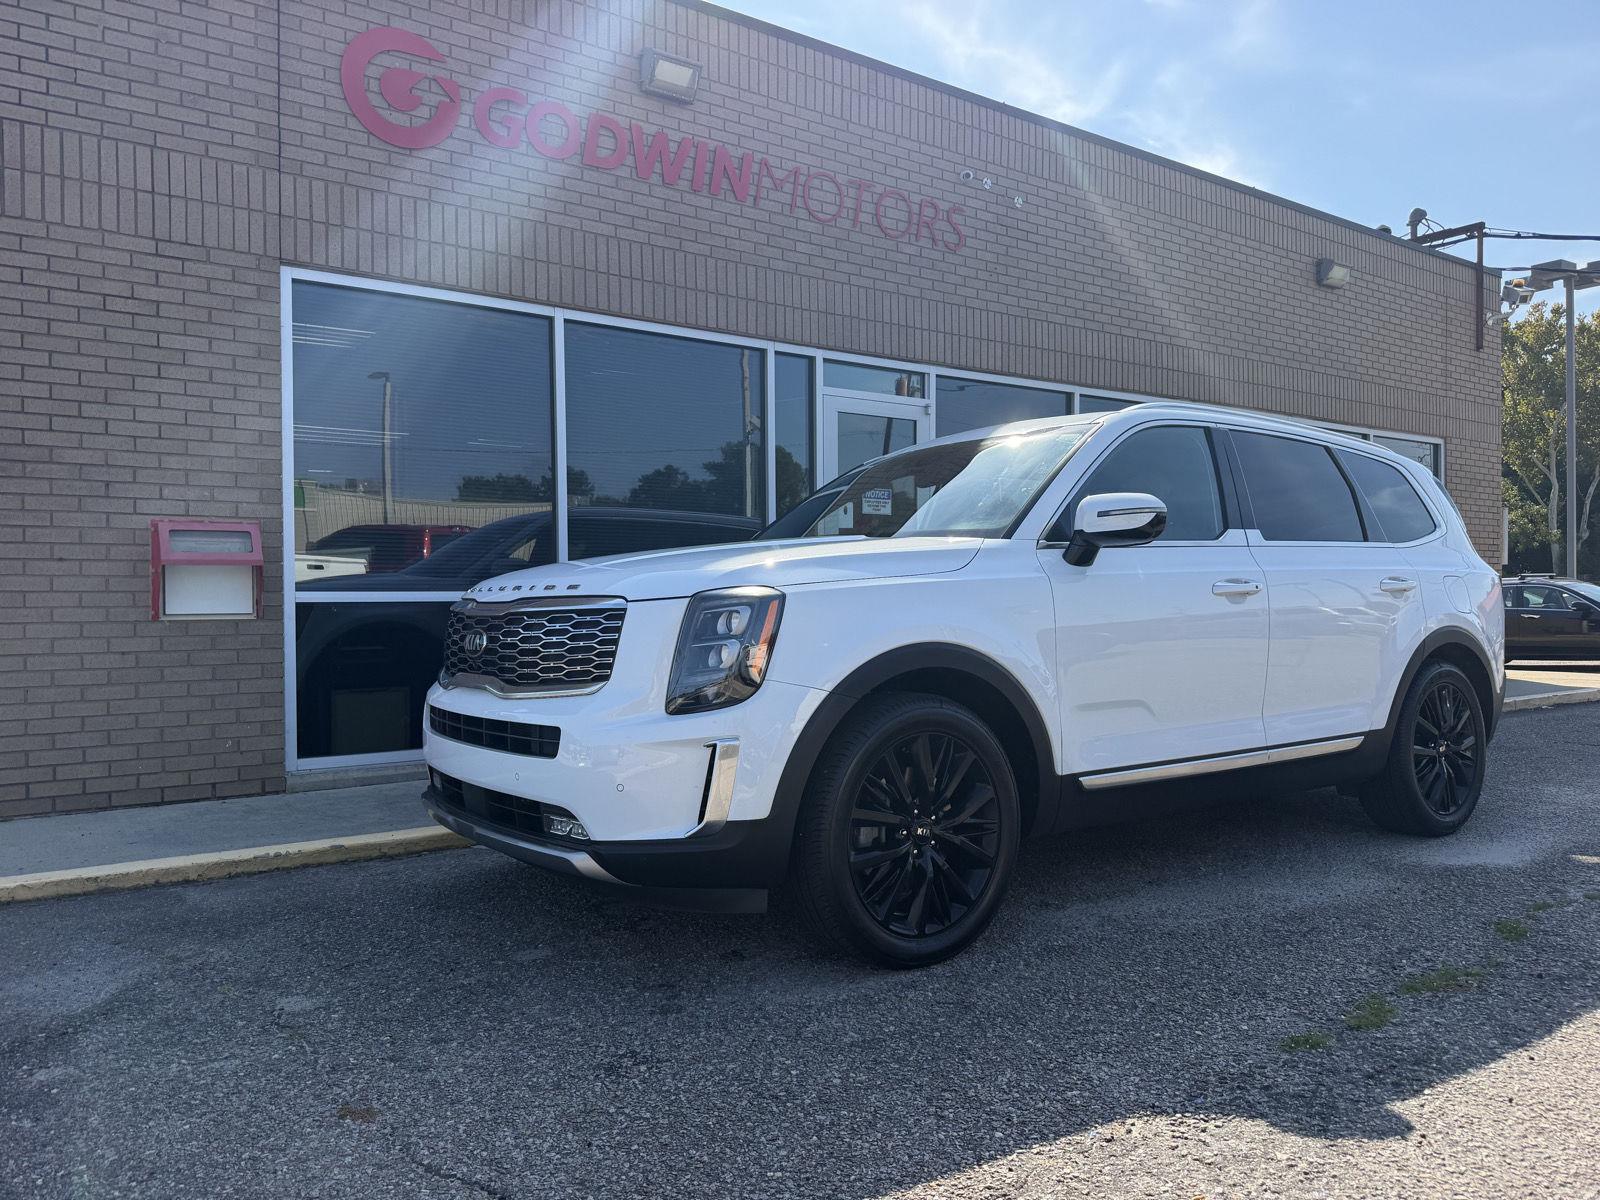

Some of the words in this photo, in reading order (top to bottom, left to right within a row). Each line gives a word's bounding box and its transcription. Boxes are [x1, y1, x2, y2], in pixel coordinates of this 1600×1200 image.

[865, 490, 890, 499] NOTICE
[467, 584, 581, 592] ELLURIDE
[916, 828, 930, 837] KIA
